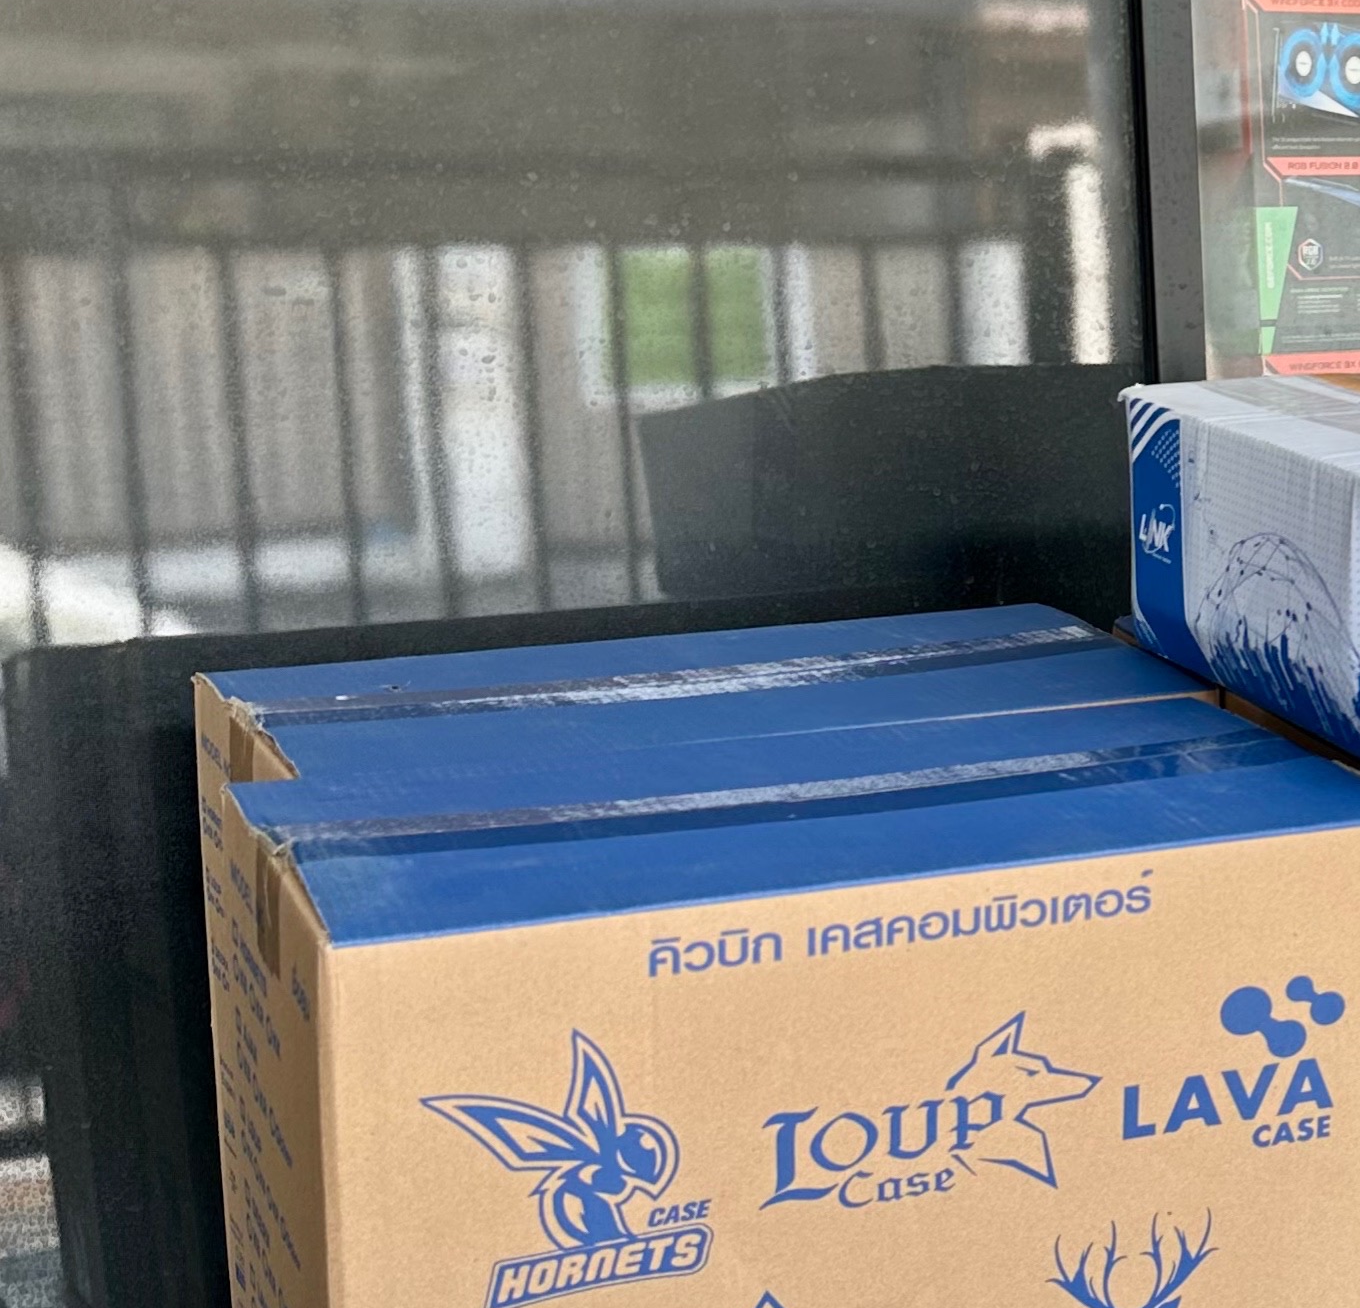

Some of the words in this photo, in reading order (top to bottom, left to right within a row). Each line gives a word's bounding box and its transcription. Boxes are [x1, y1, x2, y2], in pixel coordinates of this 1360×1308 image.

[647, 920, 784, 979] คิวบิก
[806, 869, 1156, 958] เคสคอมพิวเตอร์
[1121, 1056, 1334, 1142] LAVA
[1251, 1113, 1332, 1150] CASE
[648, 1198, 712, 1229] CASE
